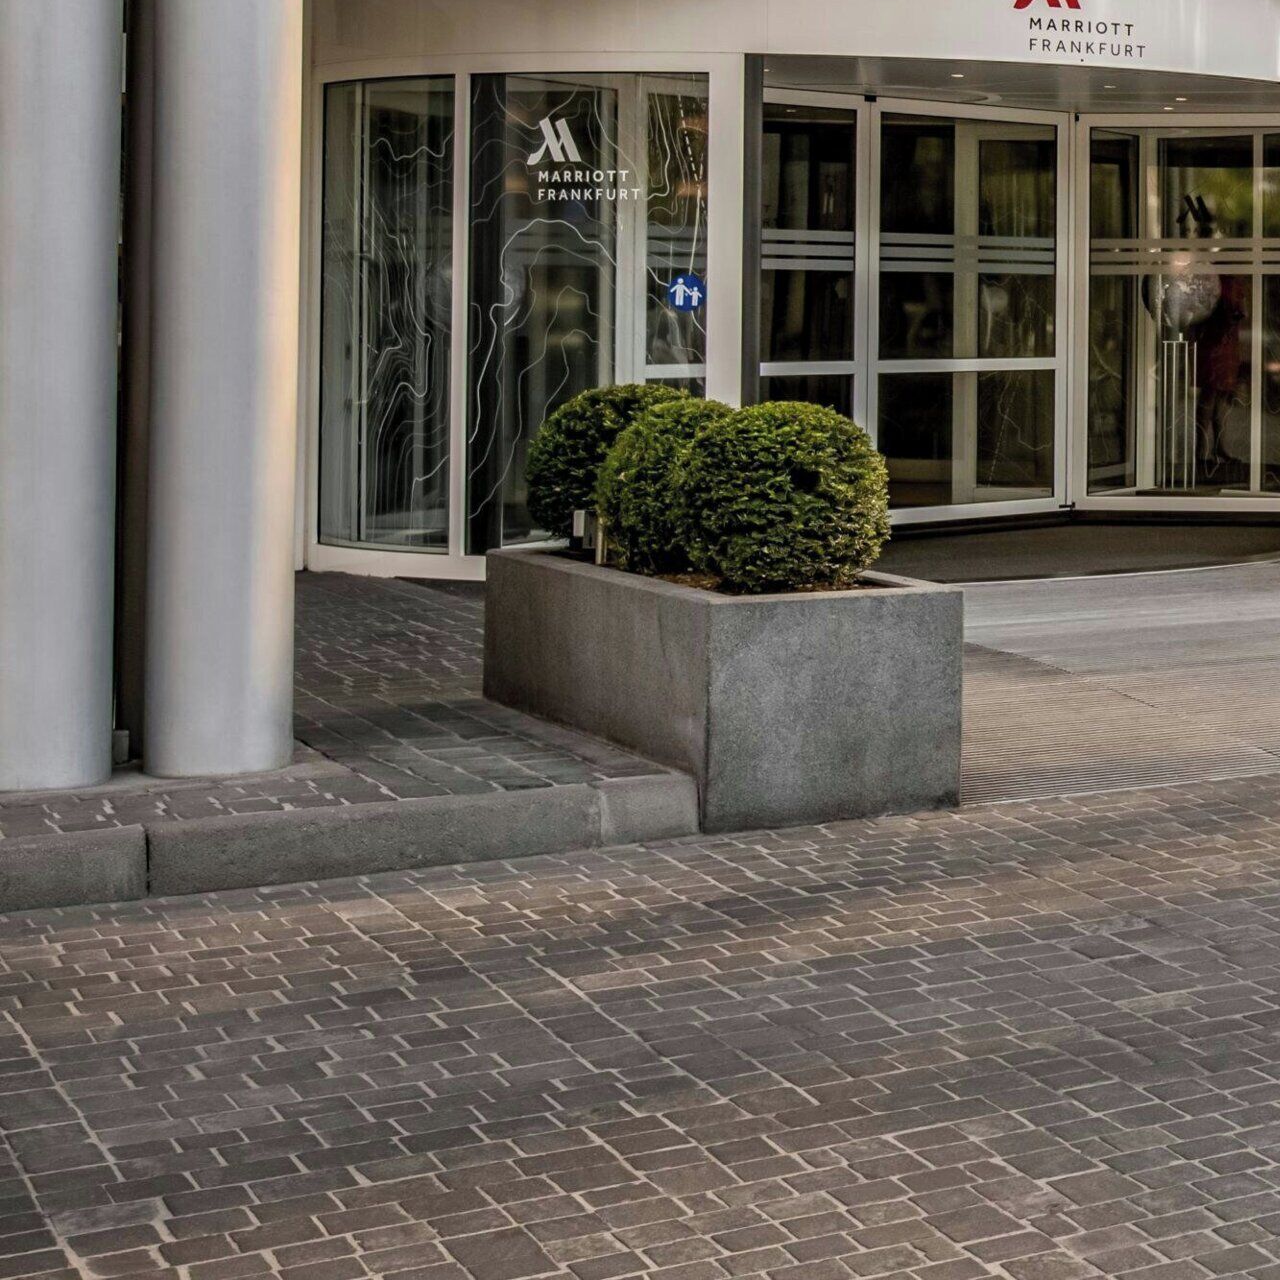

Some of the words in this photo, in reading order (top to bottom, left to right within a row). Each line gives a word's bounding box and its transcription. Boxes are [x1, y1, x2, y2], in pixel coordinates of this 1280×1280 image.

[1029, 17, 1134, 36] MARRIOTT
[1029, 38, 1146, 58] FRANKFURT
[538, 170, 629, 182] MARRIOTT
[538, 189, 640, 200] FRANKFURT
